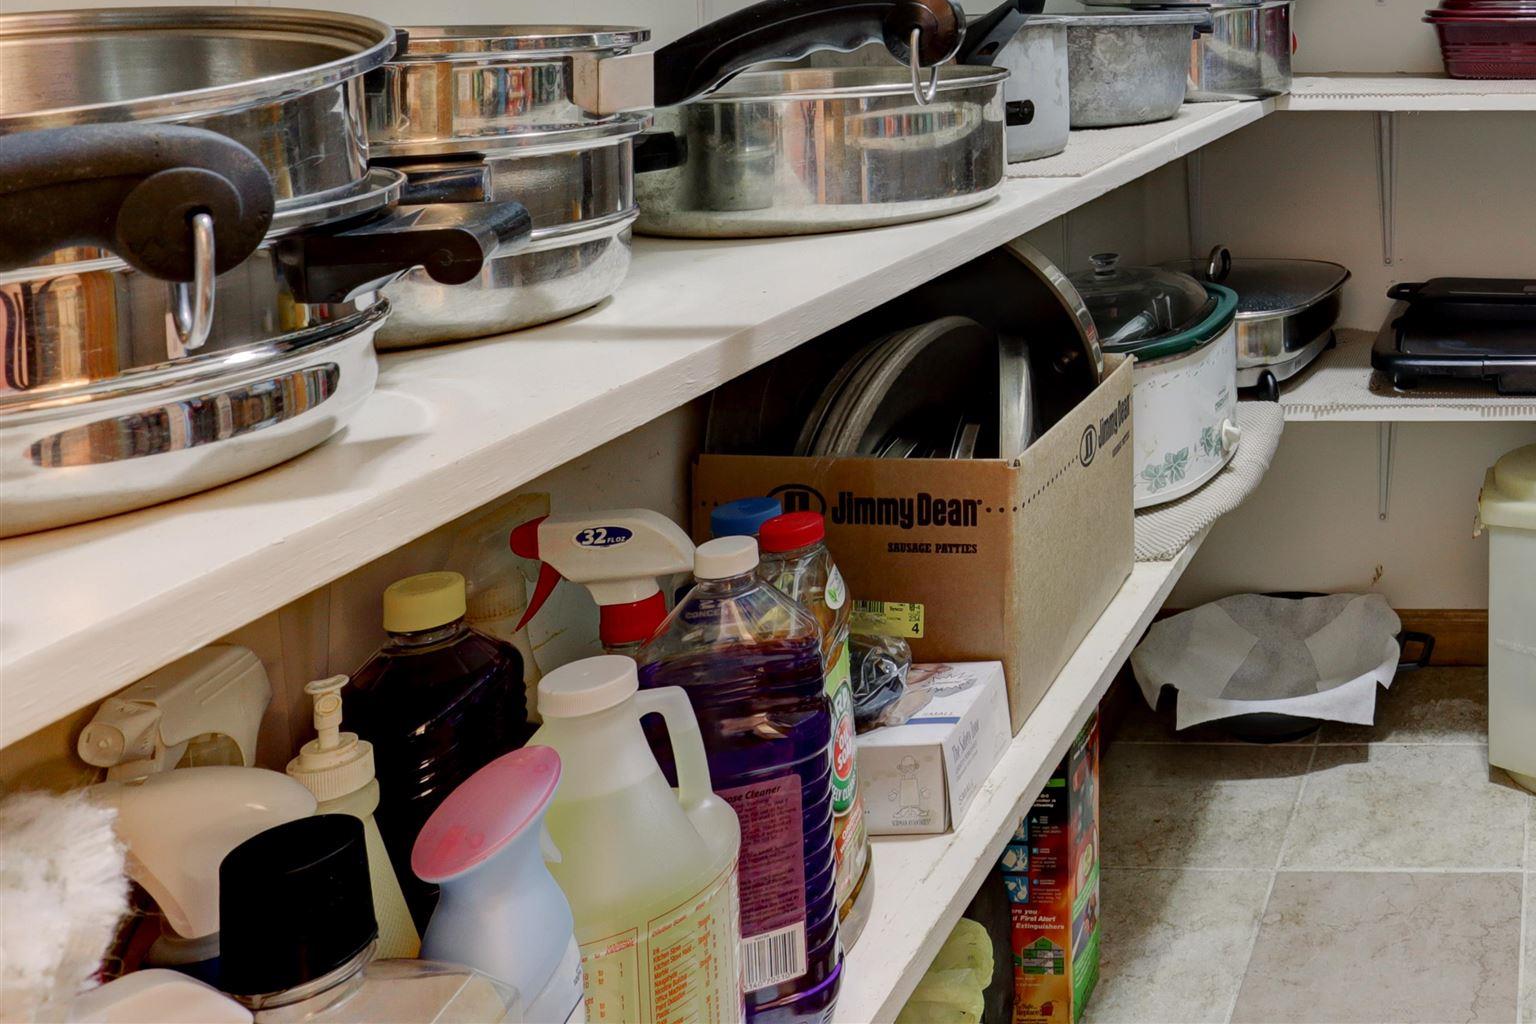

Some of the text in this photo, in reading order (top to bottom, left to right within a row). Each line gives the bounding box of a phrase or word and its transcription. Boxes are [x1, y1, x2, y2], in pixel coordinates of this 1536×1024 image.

[831, 492, 984, 530] Jimmy Dean
[581, 527, 607, 545] 32
[887, 542, 978, 555] SAUSAGE PATTIES
[911, 622, 920, 634] 4
[744, 784, 782, 801] Cleaner
[1015, 922, 1065, 930] Extinguishers
